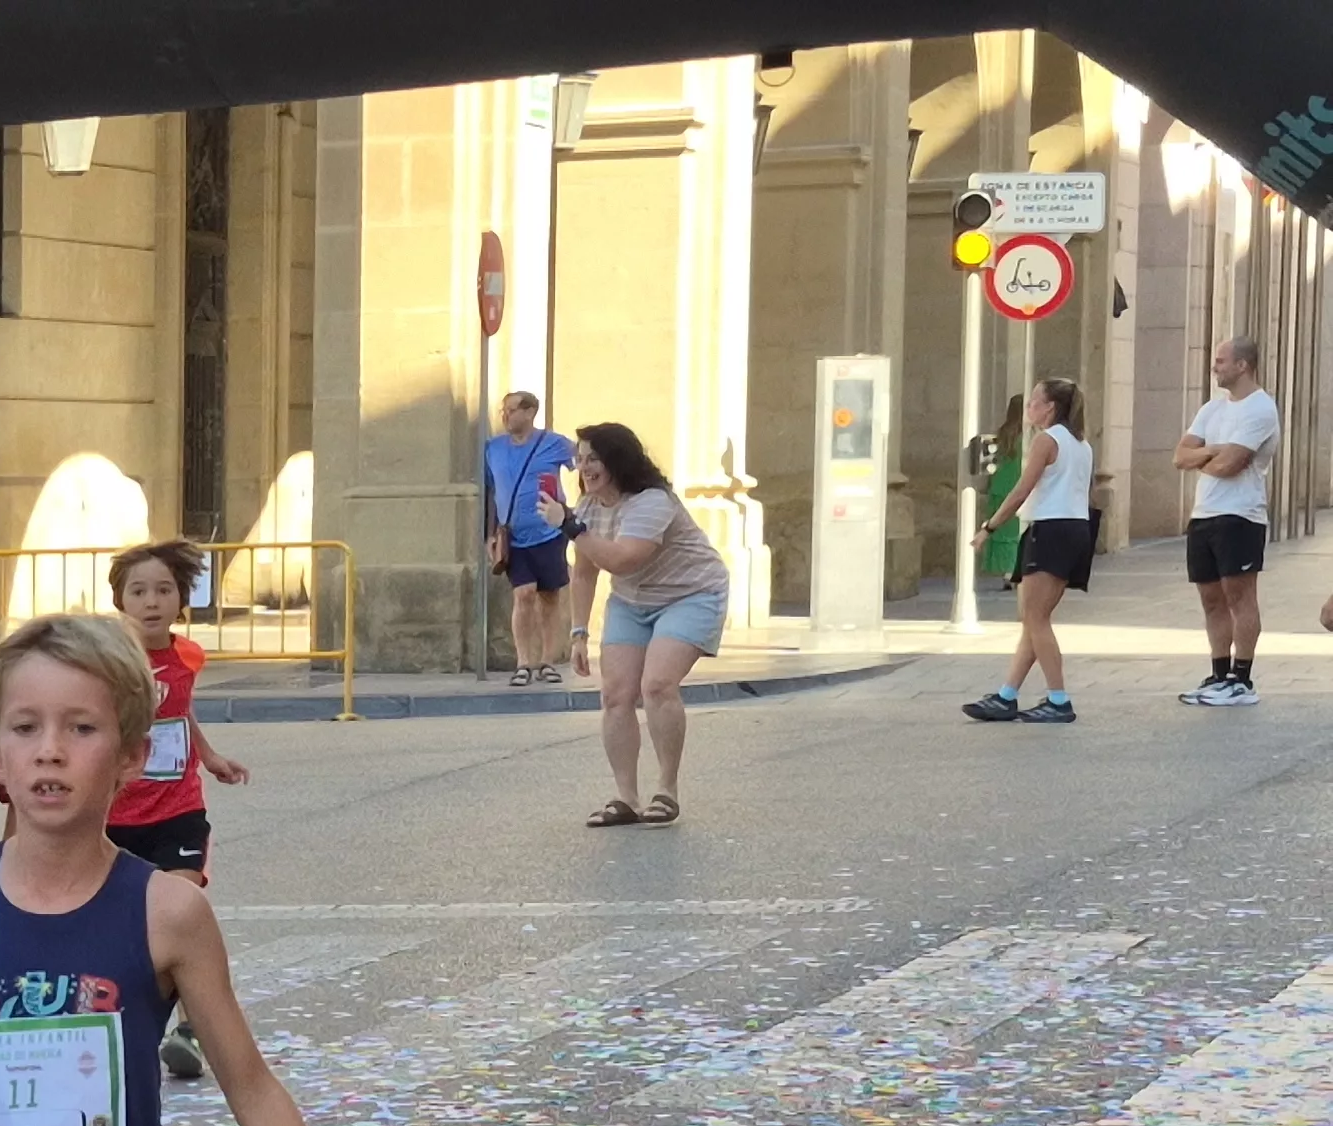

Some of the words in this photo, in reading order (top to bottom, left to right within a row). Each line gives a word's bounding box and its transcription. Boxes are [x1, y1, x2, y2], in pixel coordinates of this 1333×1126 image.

[1035, 181, 1095, 190] ESTANCIA
[20, 1029, 87, 1046] INFANTIL
[8, 1078, 39, 1110] 11
